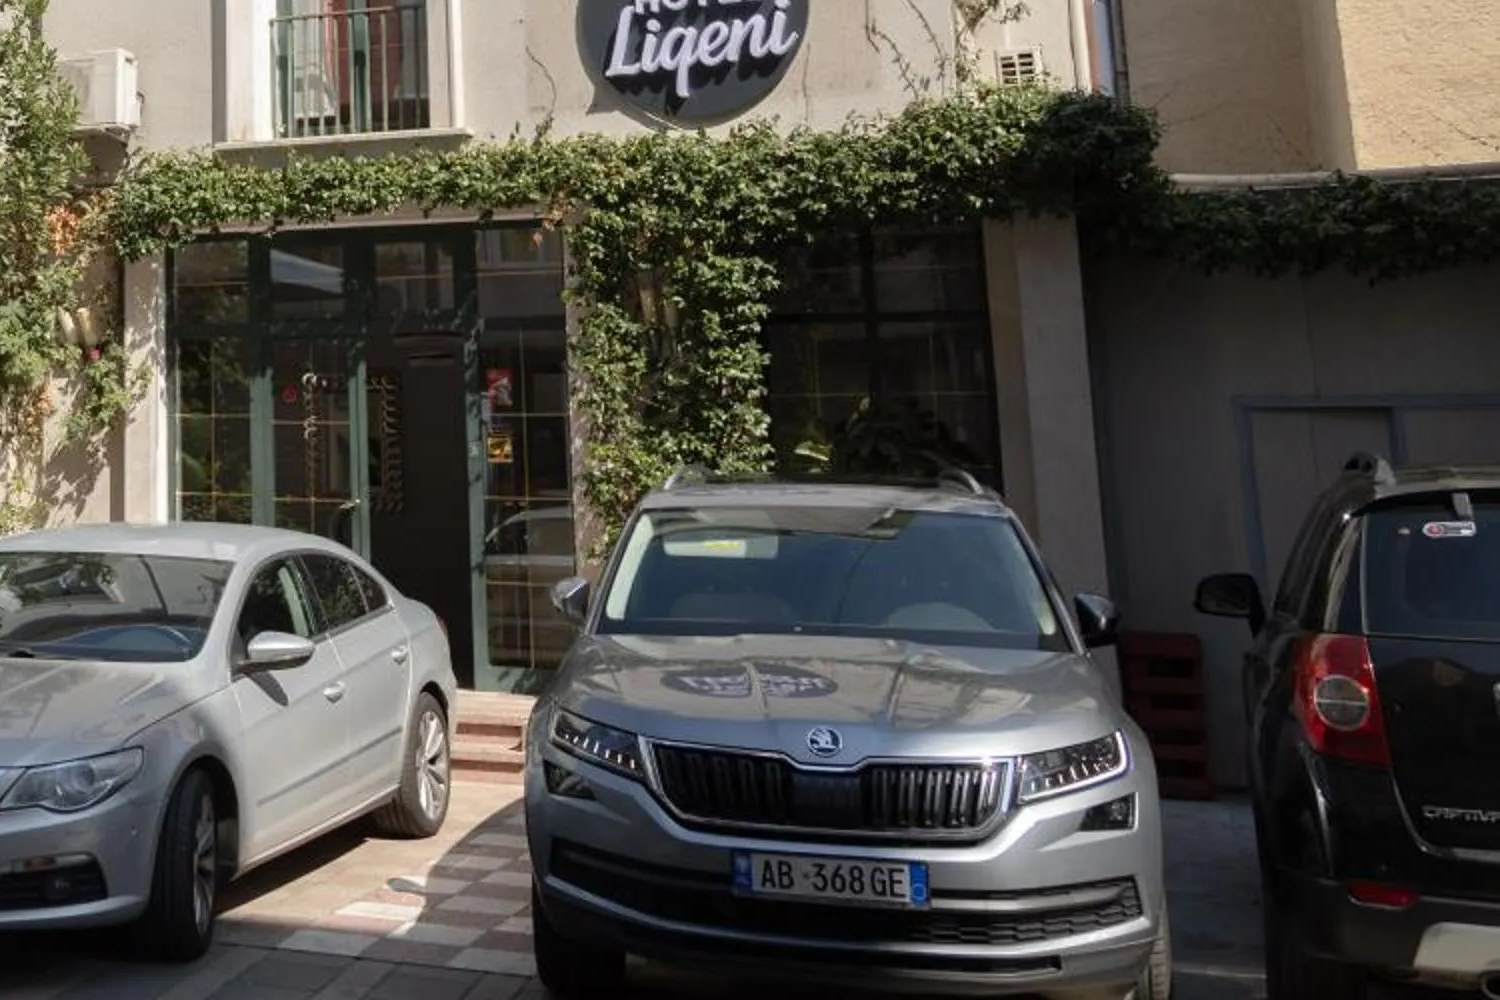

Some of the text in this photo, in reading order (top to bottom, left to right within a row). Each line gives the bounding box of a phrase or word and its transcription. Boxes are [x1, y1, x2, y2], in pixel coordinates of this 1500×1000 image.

[761, 859, 906, 899] AB 368 GE
